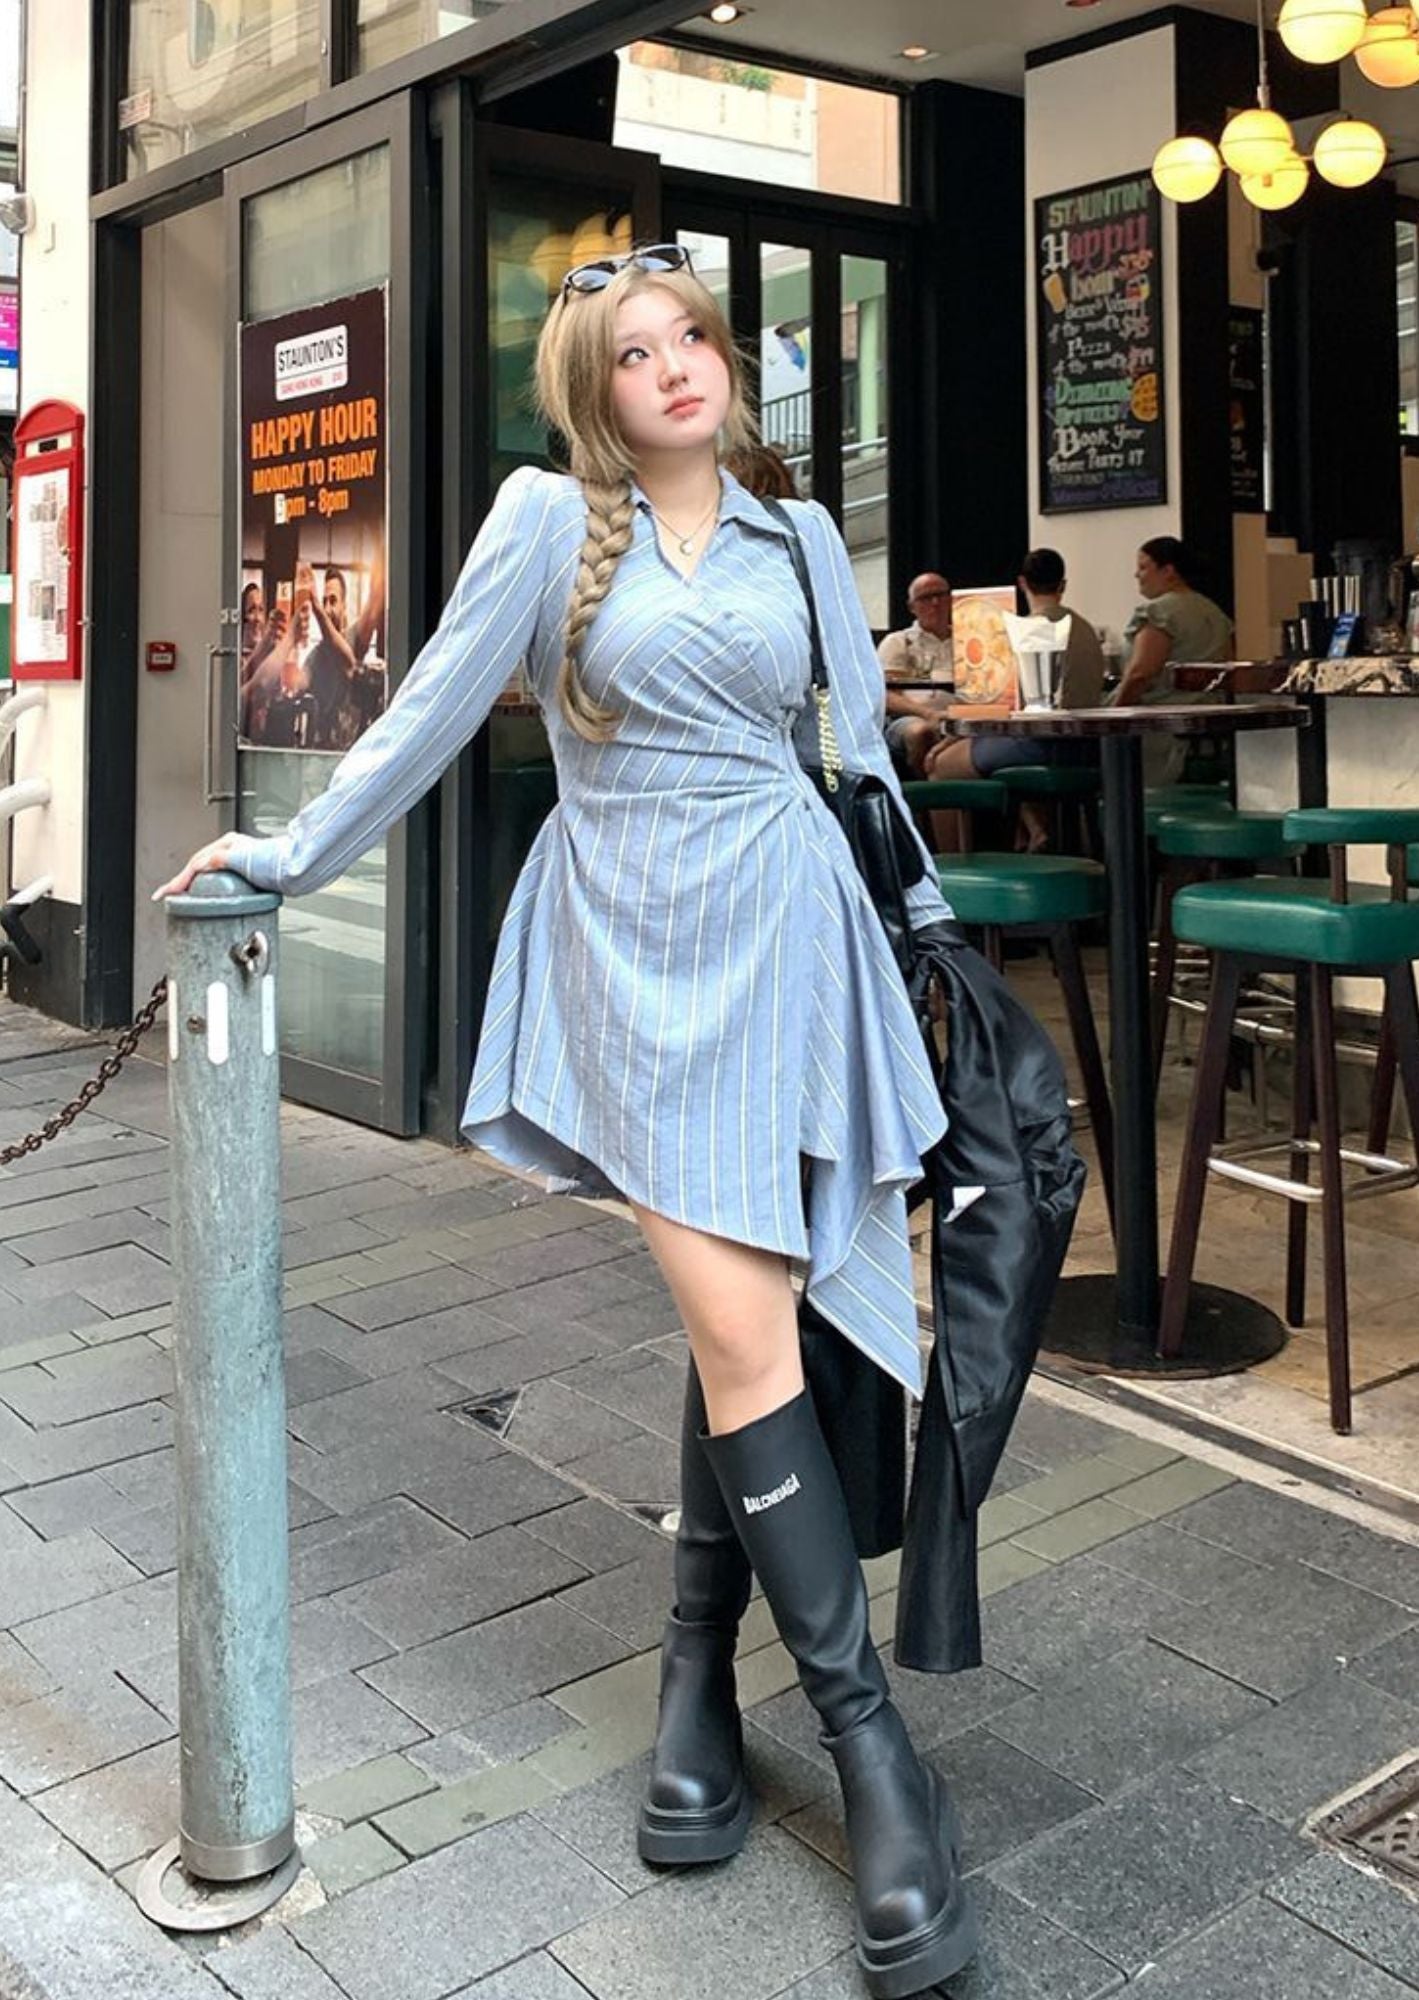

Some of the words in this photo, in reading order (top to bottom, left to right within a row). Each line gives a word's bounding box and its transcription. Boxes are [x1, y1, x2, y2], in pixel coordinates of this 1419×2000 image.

[278, 334, 344, 373] STAUNTON'S
[251, 409, 315, 460] HAPPY
[320, 397, 377, 447] HOUR
[252, 461, 305, 495] MONDAY
[307, 458, 325, 486] TO
[327, 448, 377, 483] FRIDAY
[318, 488, 349, 519] 8pm
